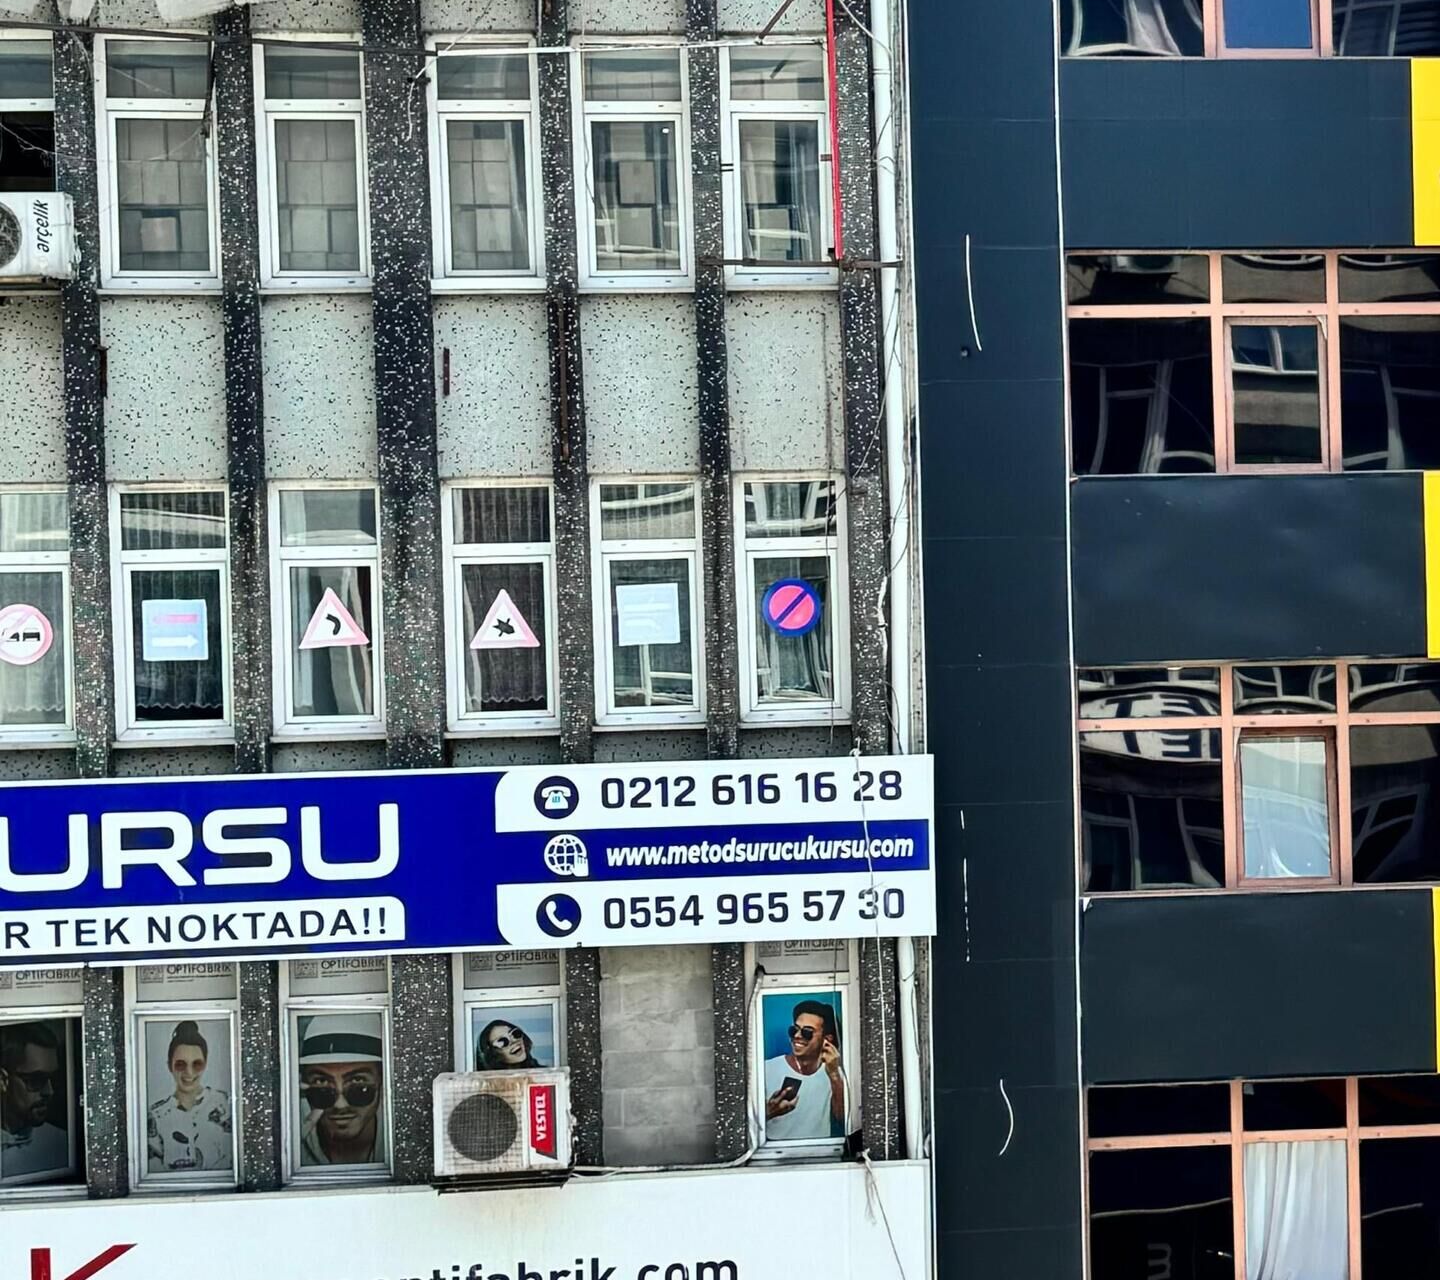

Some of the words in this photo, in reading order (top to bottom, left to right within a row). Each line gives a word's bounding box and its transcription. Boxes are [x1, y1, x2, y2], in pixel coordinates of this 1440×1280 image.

[33, 200, 52, 253] arçelik
[601, 775, 697, 809] 0212
[711, 773, 782, 806] 616
[795, 771, 838, 803] 16
[853, 769, 903, 802] 28
[0, 803, 400, 893] URSU
[605, 835, 915, 867] www.metodsurucukursu.com
[46, 917, 131, 948] TEK
[147, 907, 387, 945] NOKTADA!!
[603, 896, 704, 930] 0554
[716, 892, 790, 926] 965
[802, 889, 846, 922] 57
[857, 887, 906, 921] 30
[535, 1093, 547, 1142] VESTEL
